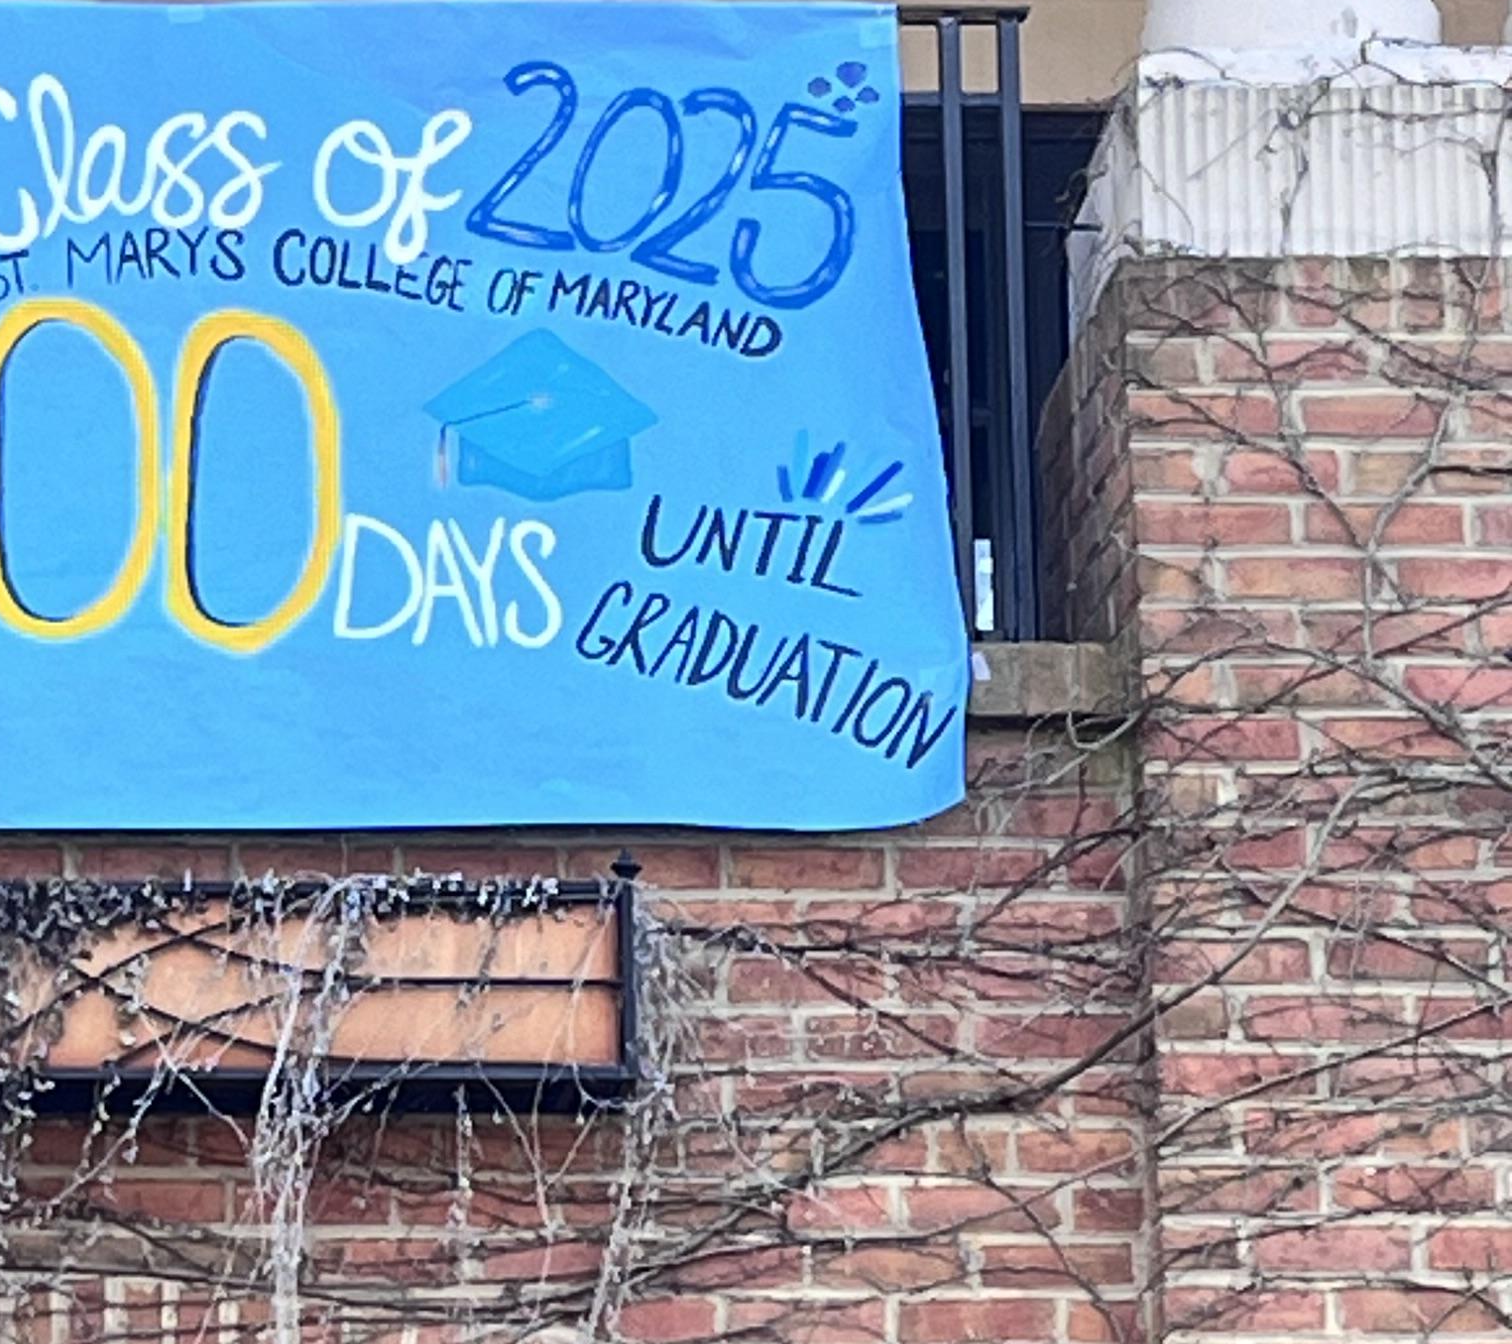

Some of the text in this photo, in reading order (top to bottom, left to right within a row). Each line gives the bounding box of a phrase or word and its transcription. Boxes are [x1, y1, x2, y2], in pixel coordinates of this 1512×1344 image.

[465, 60, 859, 310] 2025
[67, 224, 248, 290] MARYS
[273, 228, 474, 312] COLLEGE
[487, 266, 543, 317] OF
[547, 268, 784, 358] MARYLAND
[333, 513, 563, 649] DAYS
[640, 494, 863, 598] UNTIL
[575, 580, 958, 770] GRADUATION
